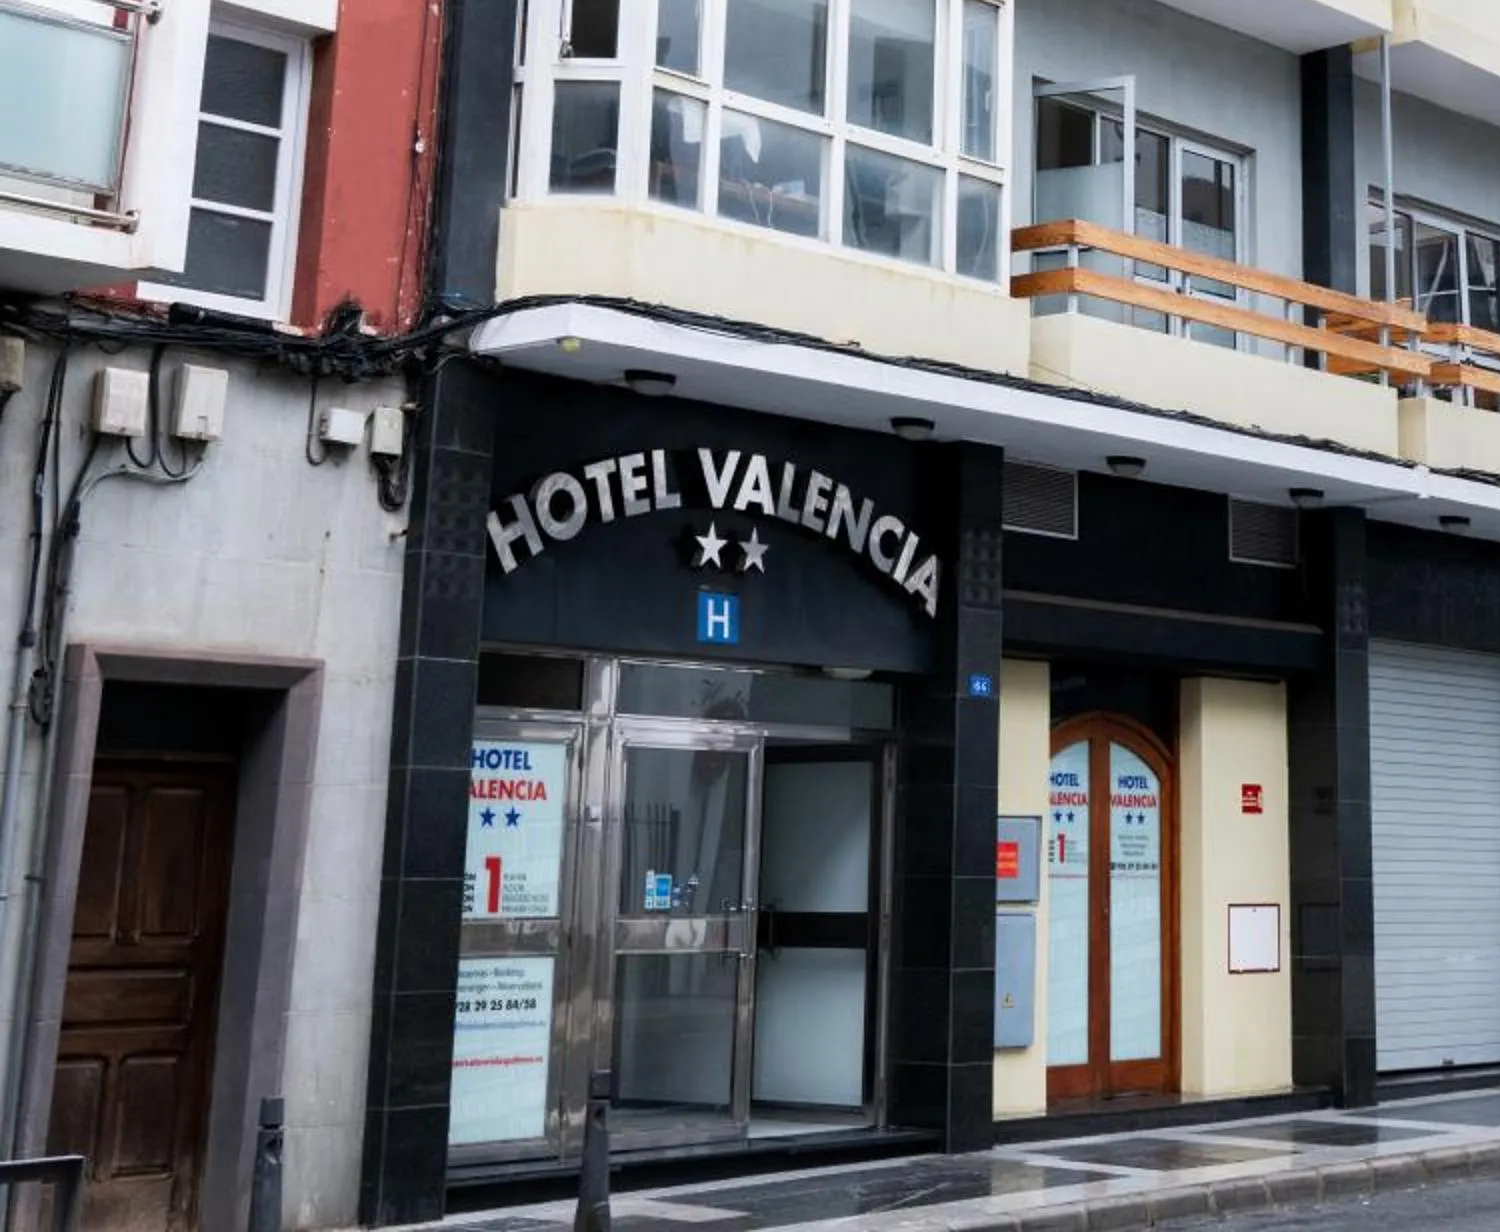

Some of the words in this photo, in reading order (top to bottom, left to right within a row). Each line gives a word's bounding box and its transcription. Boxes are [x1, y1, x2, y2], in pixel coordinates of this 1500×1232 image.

[486, 448, 682, 574] HOTEL
[697, 447, 940, 620] VALENCIA
[707, 599, 730, 639] H
[471, 748, 532, 770] HOTEL
[467, 779, 547, 800] ALENCIA
[1118, 775, 1149, 789] HOTEL
[1050, 792, 1088, 806] LENCIA
[1111, 794, 1157, 808] VALENCIA
[485, 855, 502, 914] 1
